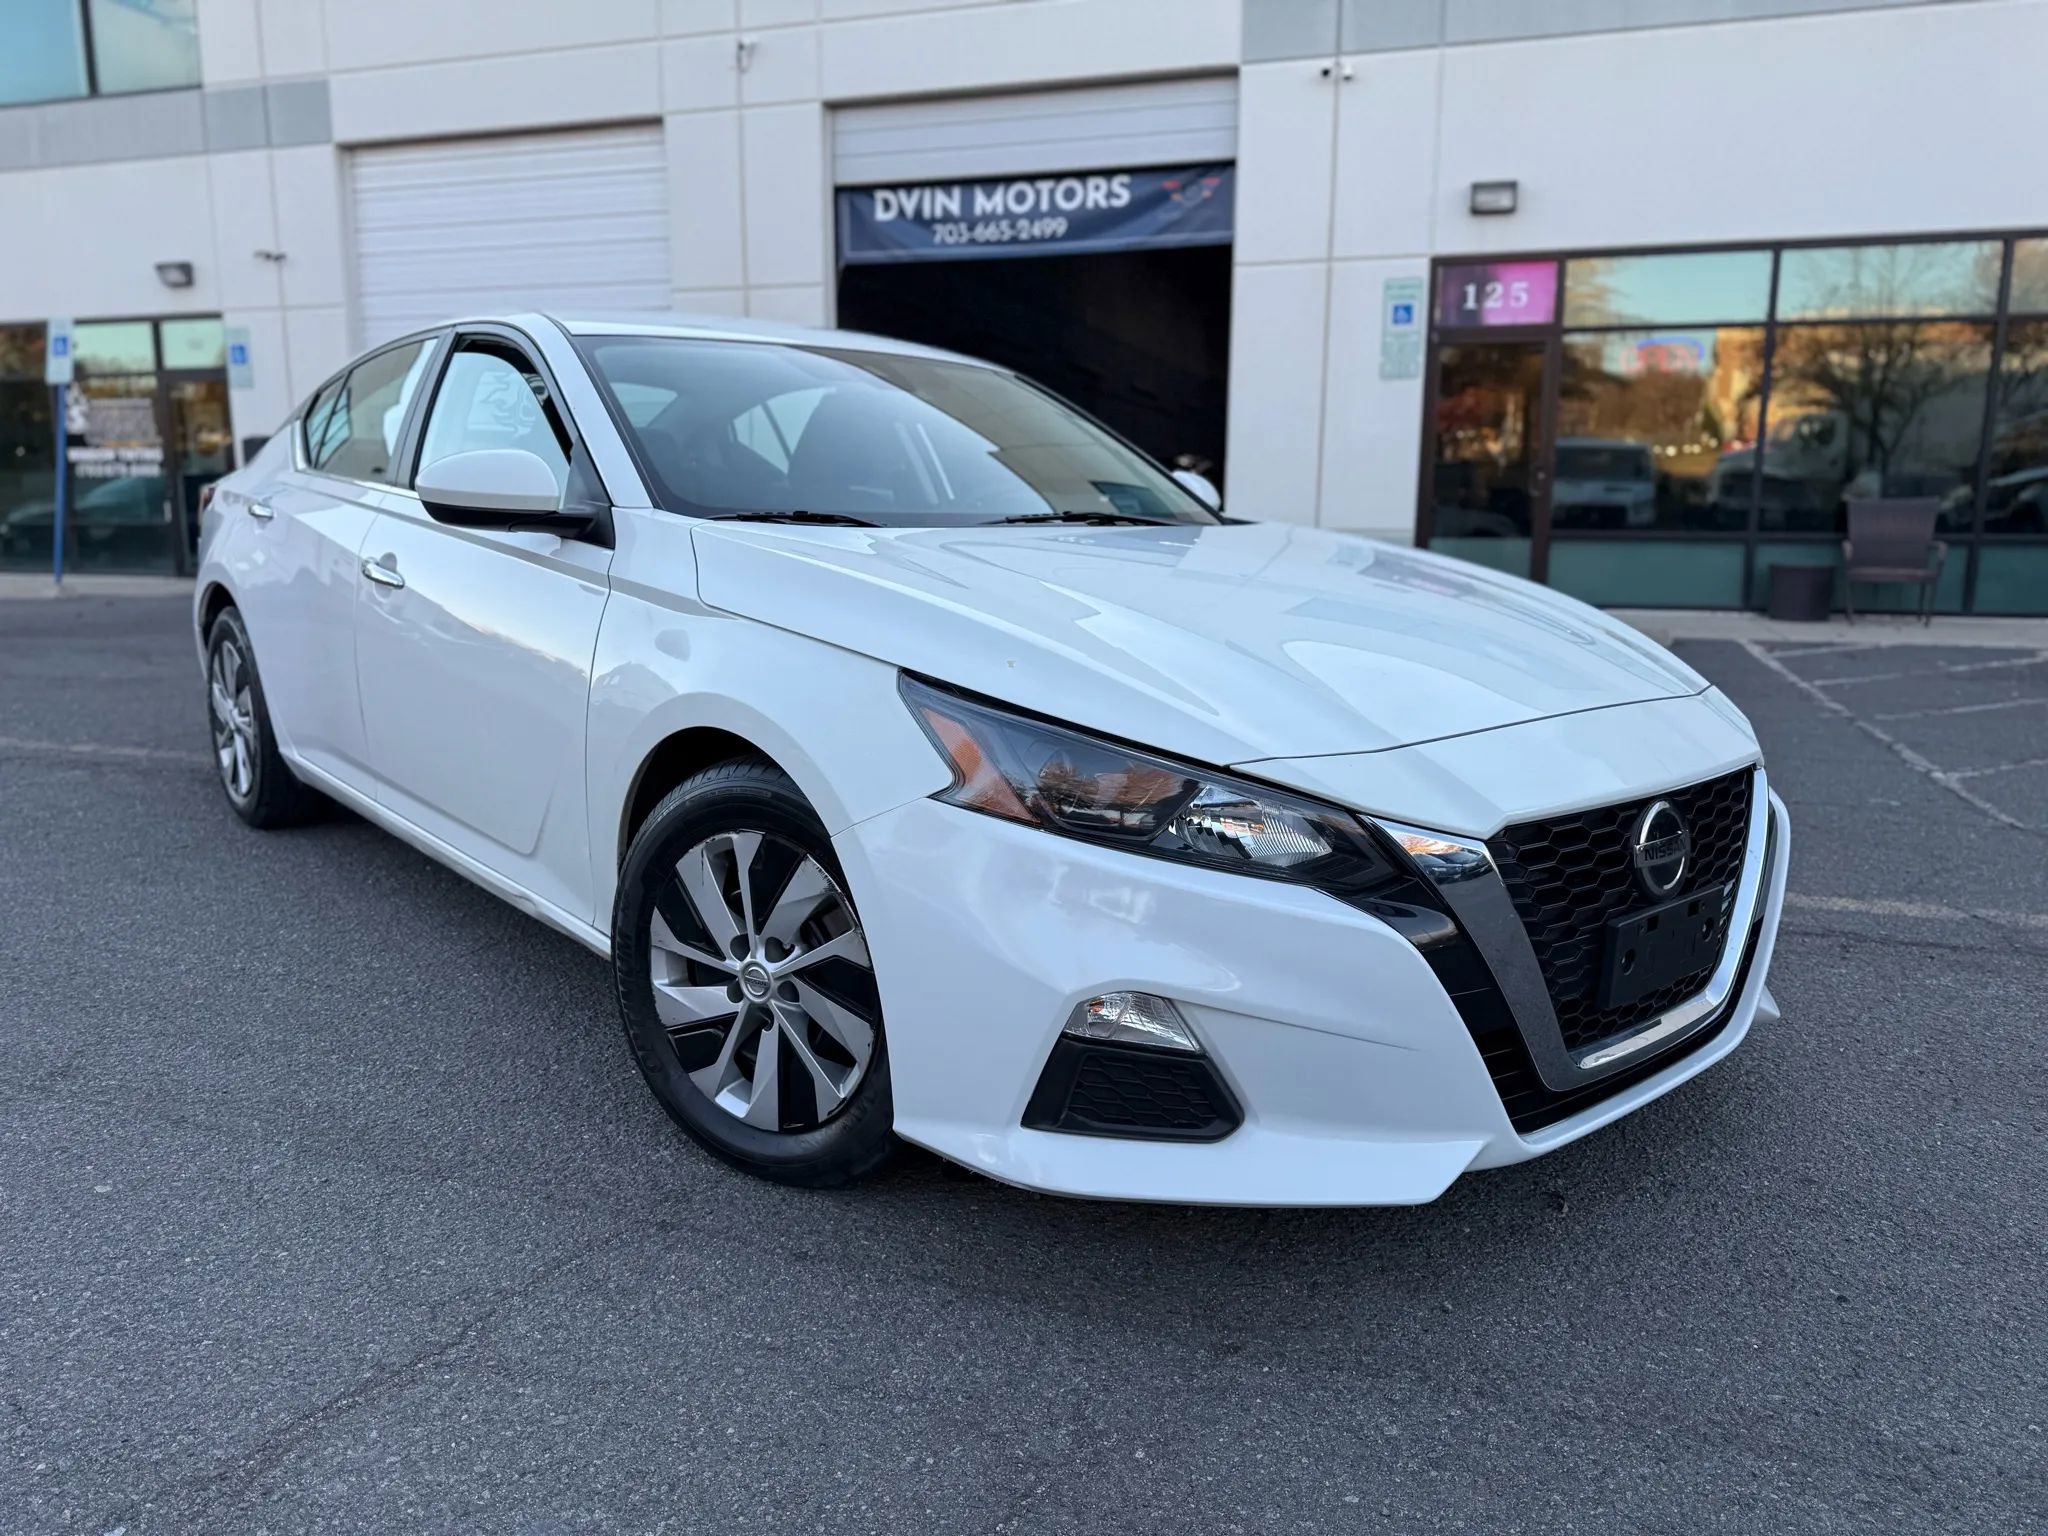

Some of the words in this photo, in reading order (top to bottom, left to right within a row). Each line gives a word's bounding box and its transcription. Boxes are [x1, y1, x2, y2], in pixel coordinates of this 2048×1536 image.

[873, 187, 961, 221] DVIN
[974, 175, 1131, 217] MOTORS
[932, 217, 1068, 244] 703-665-2499
[1463, 281, 1528, 310] 125
[1644, 838, 1686, 861] NISSAN
